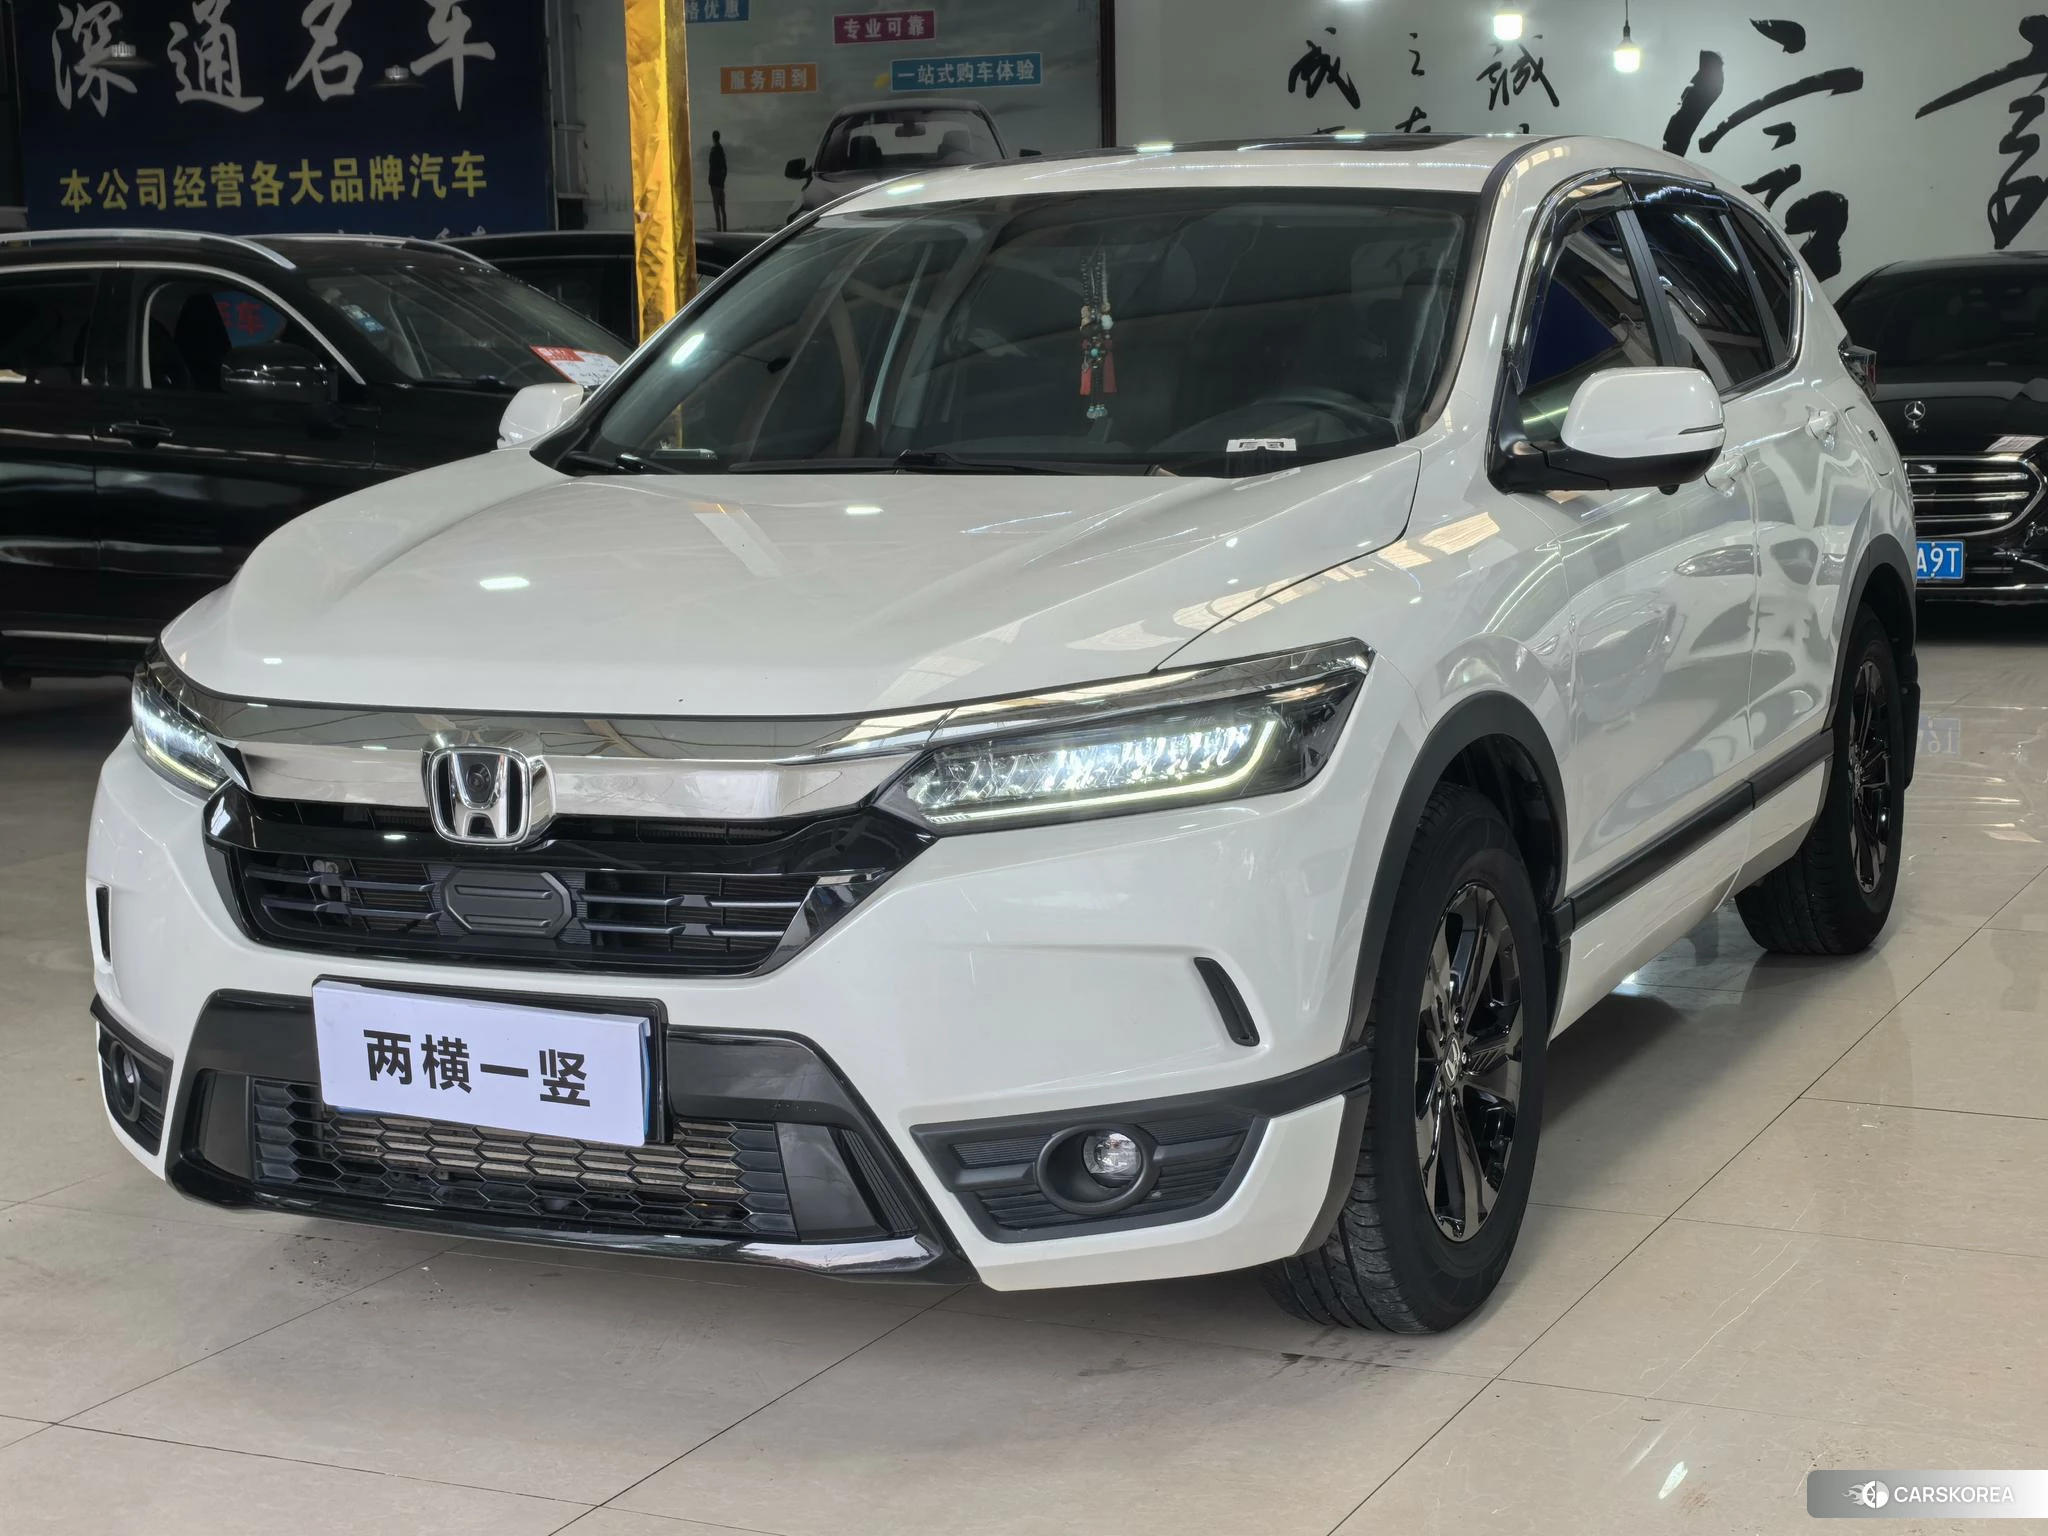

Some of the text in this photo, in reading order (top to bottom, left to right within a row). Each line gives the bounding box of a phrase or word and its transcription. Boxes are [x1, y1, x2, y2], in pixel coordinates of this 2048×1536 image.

[843, 14, 926, 40] 专业可靠
[730, 67, 808, 90] 服务周到
[897, 59, 1035, 85] 一站式购车体验
[59, 150, 488, 213] 本公司经营各大品牌汽车
[363, 1028, 591, 1108] 两横一竖
